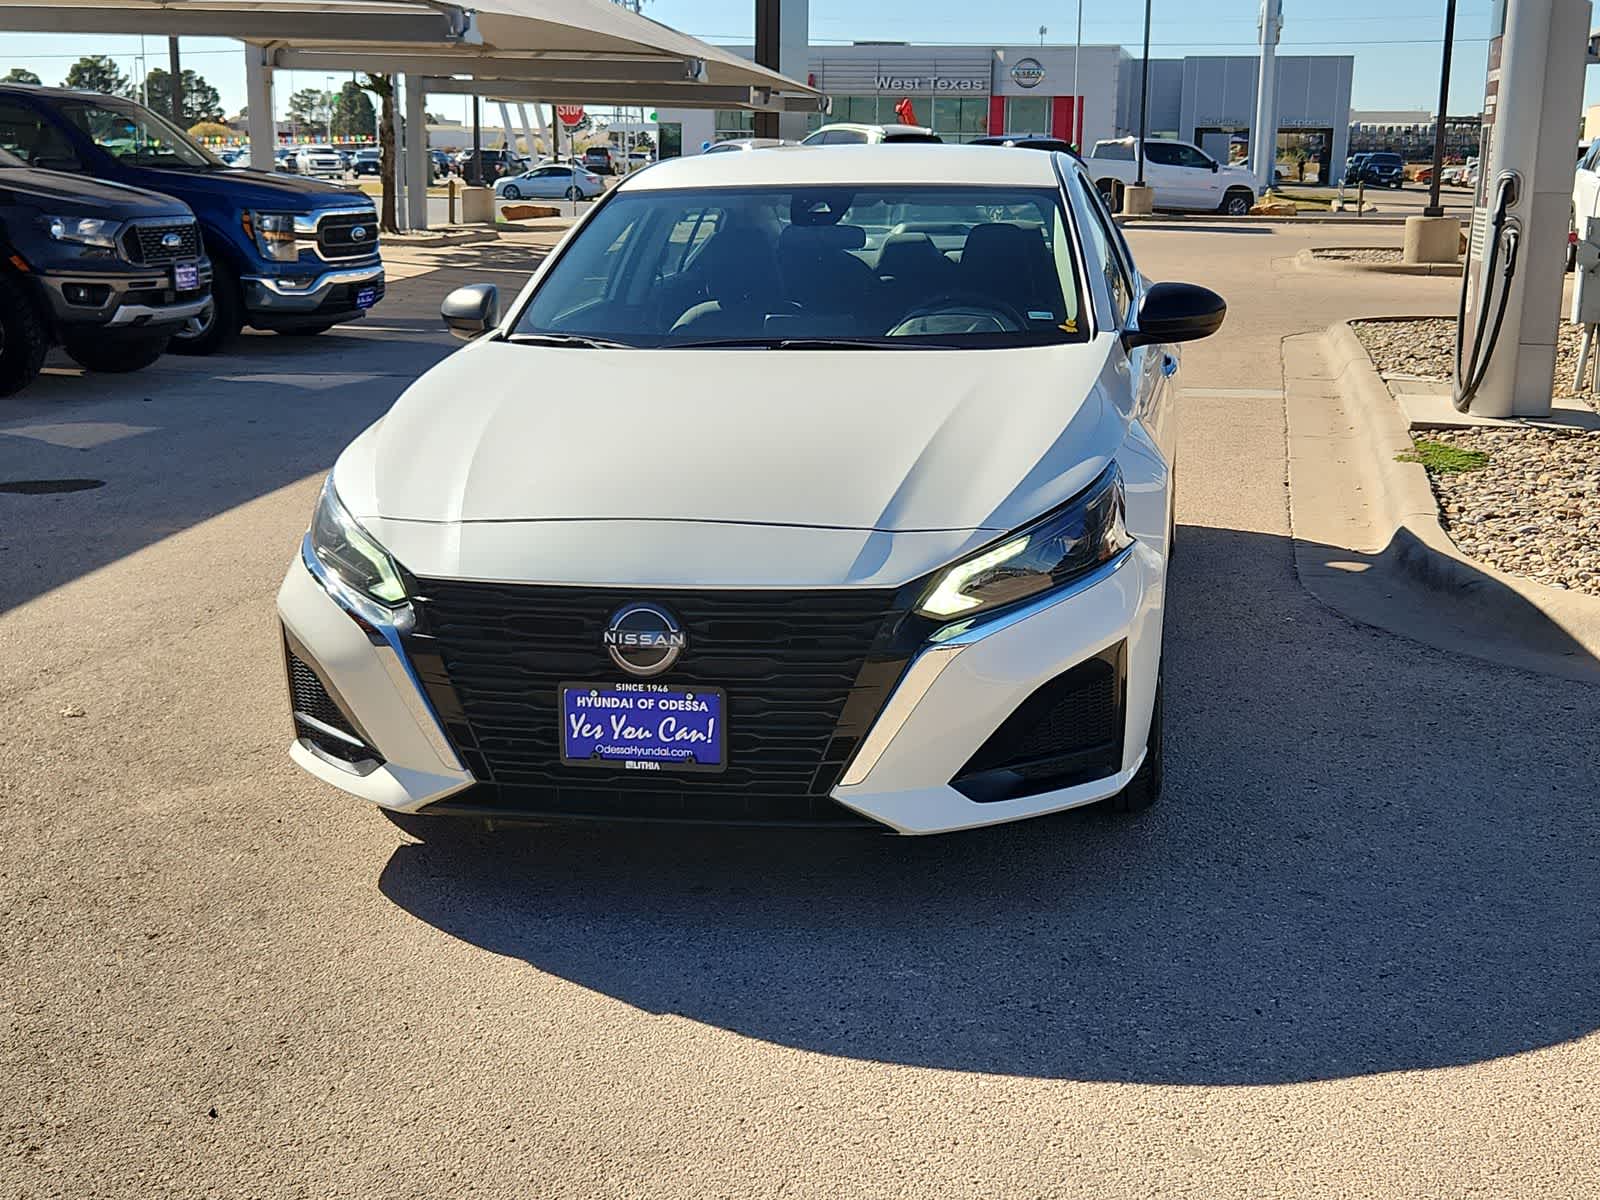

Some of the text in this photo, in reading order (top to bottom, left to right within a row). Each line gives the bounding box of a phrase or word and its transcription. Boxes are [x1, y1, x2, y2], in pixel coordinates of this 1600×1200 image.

[874, 76, 984, 90] West Texas
[559, 105, 581, 115] STOP
[603, 631, 684, 647] NISSAN
[615, 683, 669, 693] SINCE 1946
[576, 695, 709, 712] HYUNDAI OF ODESSA
[569, 713, 715, 744] Yes You Can!
[595, 744, 693, 757] OdessaHyundai.com
